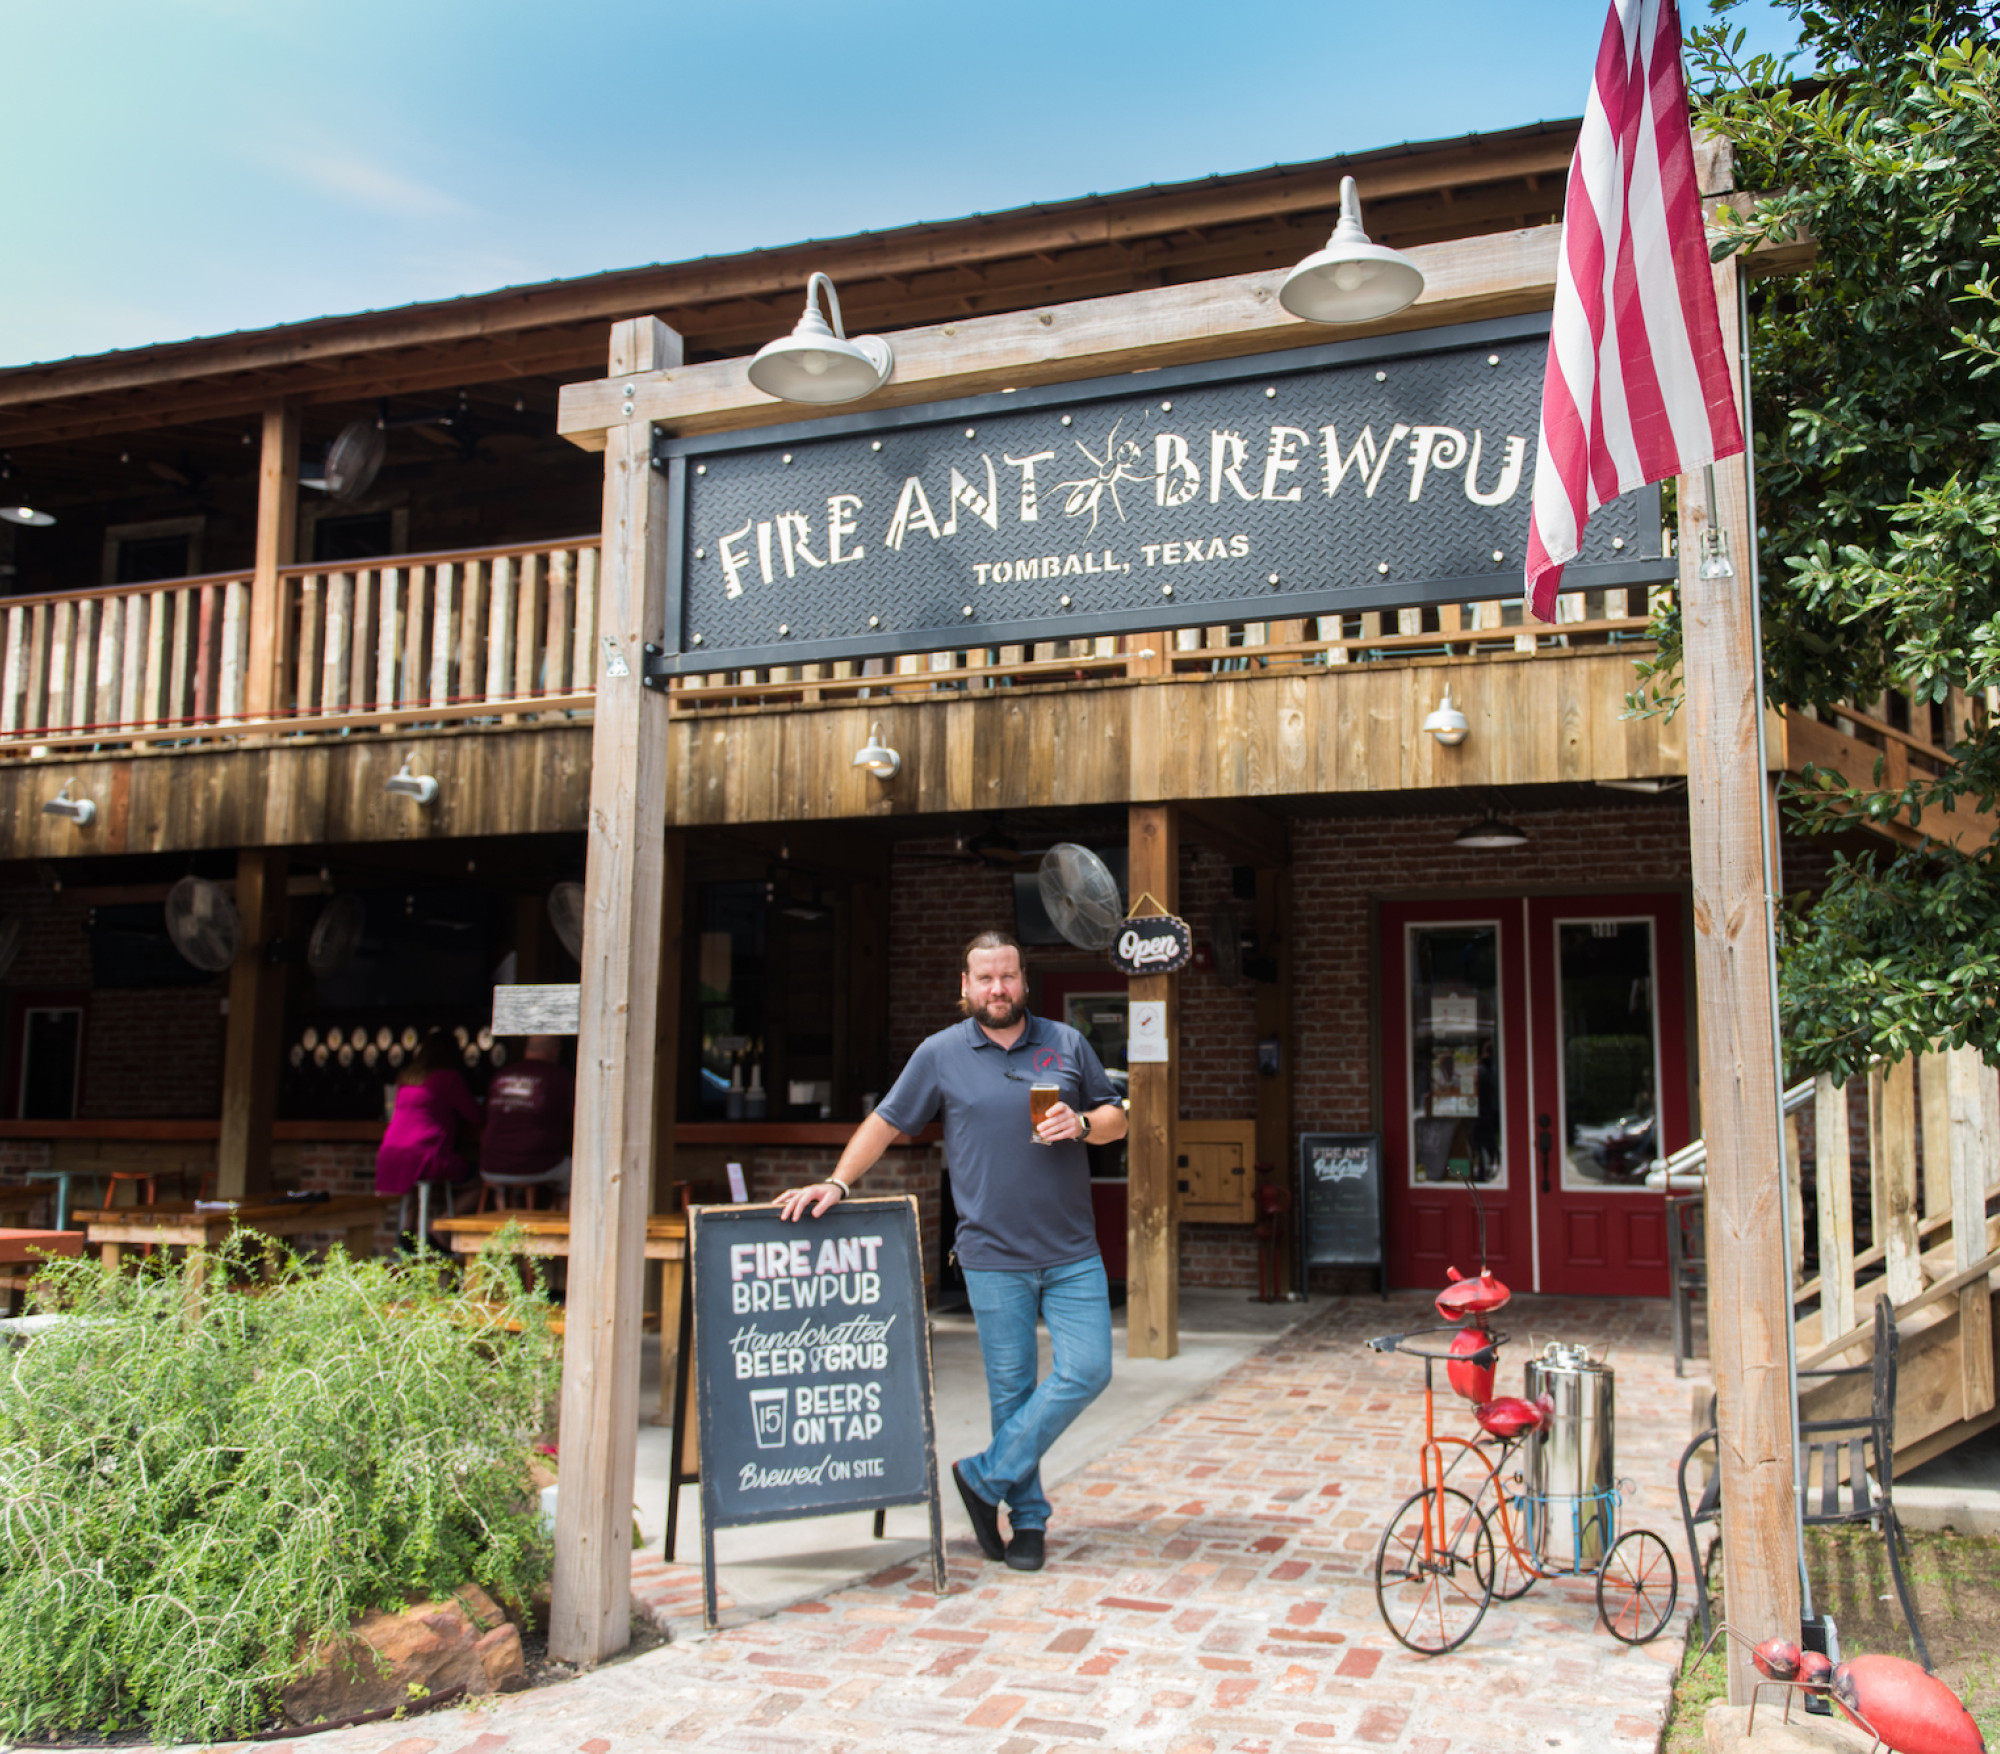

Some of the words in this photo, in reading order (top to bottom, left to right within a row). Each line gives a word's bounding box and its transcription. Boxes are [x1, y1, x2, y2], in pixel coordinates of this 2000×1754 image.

[717, 493, 865, 600] FIRE
[885, 452, 1055, 551] ANT
[1155, 422, 1534, 506] BREWPU
[973, 550, 1131, 586] TOMBALL,
[1141, 535, 1250, 568] TEXAS
[1118, 930, 1180, 968] Open
[730, 1240, 811, 1281] FIRE
[815, 1236, 882, 1275] ANT
[732, 1272, 881, 1315] BREWPUB
[728, 1314, 896, 1354] Handcrafted
[735, 1349, 805, 1379] BEER
[824, 1343, 889, 1372] GRUB
[795, 1382, 882, 1416] BEERS
[759, 1405, 782, 1434] 15
[793, 1416, 825, 1445] ON
[828, 1414, 882, 1442] TAP
[739, 1454, 831, 1491] Brewed
[828, 1461, 850, 1481] ON
[853, 1458, 885, 1478] SITE
